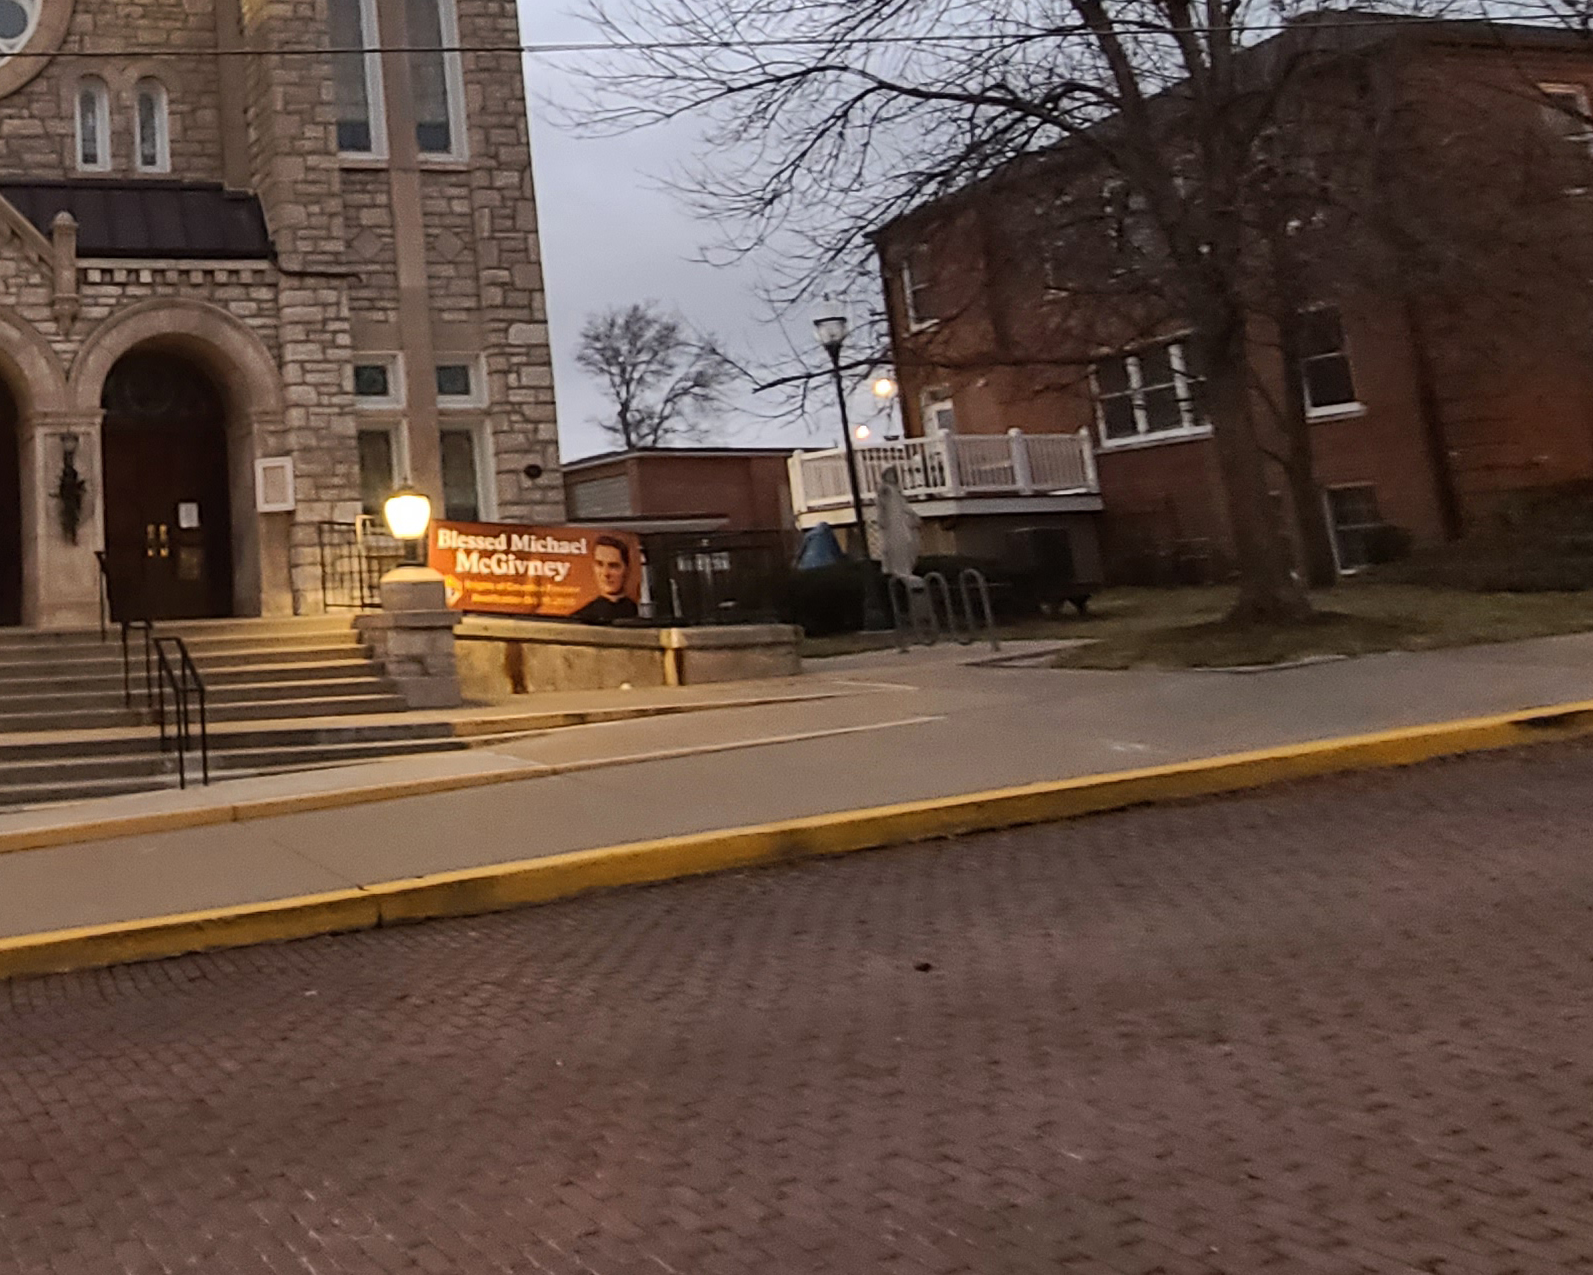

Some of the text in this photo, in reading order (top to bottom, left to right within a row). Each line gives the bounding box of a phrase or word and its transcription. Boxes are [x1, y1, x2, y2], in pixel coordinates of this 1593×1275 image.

[437, 528, 588, 554] Blessed Michael
[455, 548, 572, 582] McGivney
